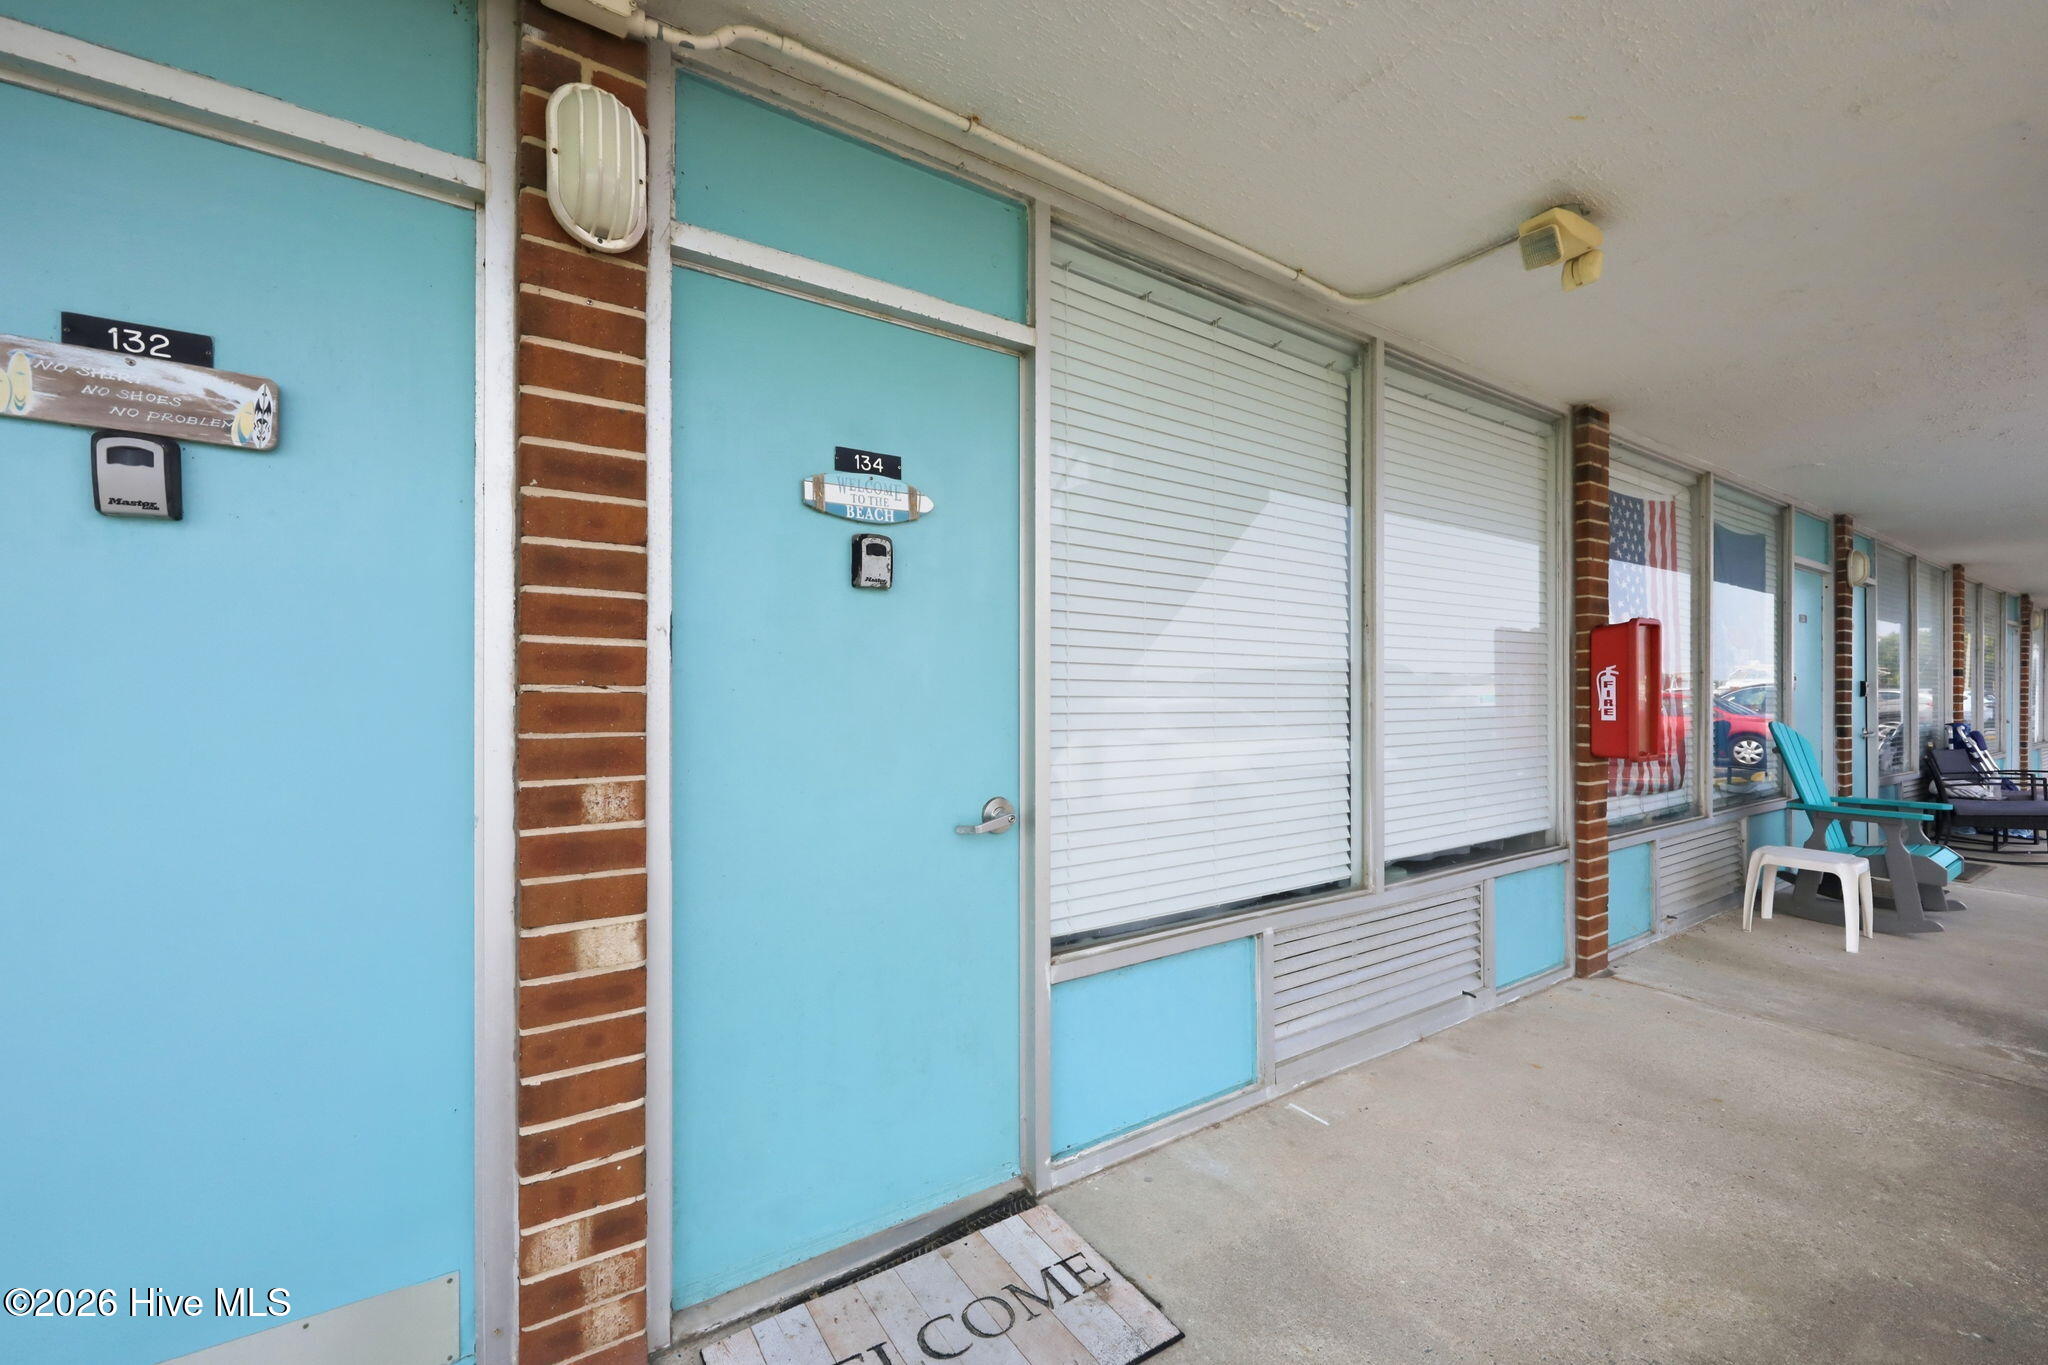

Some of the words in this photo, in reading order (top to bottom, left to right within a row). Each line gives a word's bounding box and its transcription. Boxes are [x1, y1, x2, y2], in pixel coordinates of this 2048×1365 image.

[107, 327, 172, 359] 132
[33, 360, 69, 373] NO
[81, 384, 111, 397] NO
[116, 389, 183, 408] SHOES
[109, 406, 140, 418] NO
[146, 410, 235, 429] PROBLEM
[854, 454, 884, 473] 134
[837, 475, 902, 502] WELCOME
[107, 497, 158, 507] Master
[850, 493, 866, 505] TO
[868, 495, 890, 508] THE
[846, 504, 896, 523] BEACH
[1603, 680, 1615, 716] FIRE
